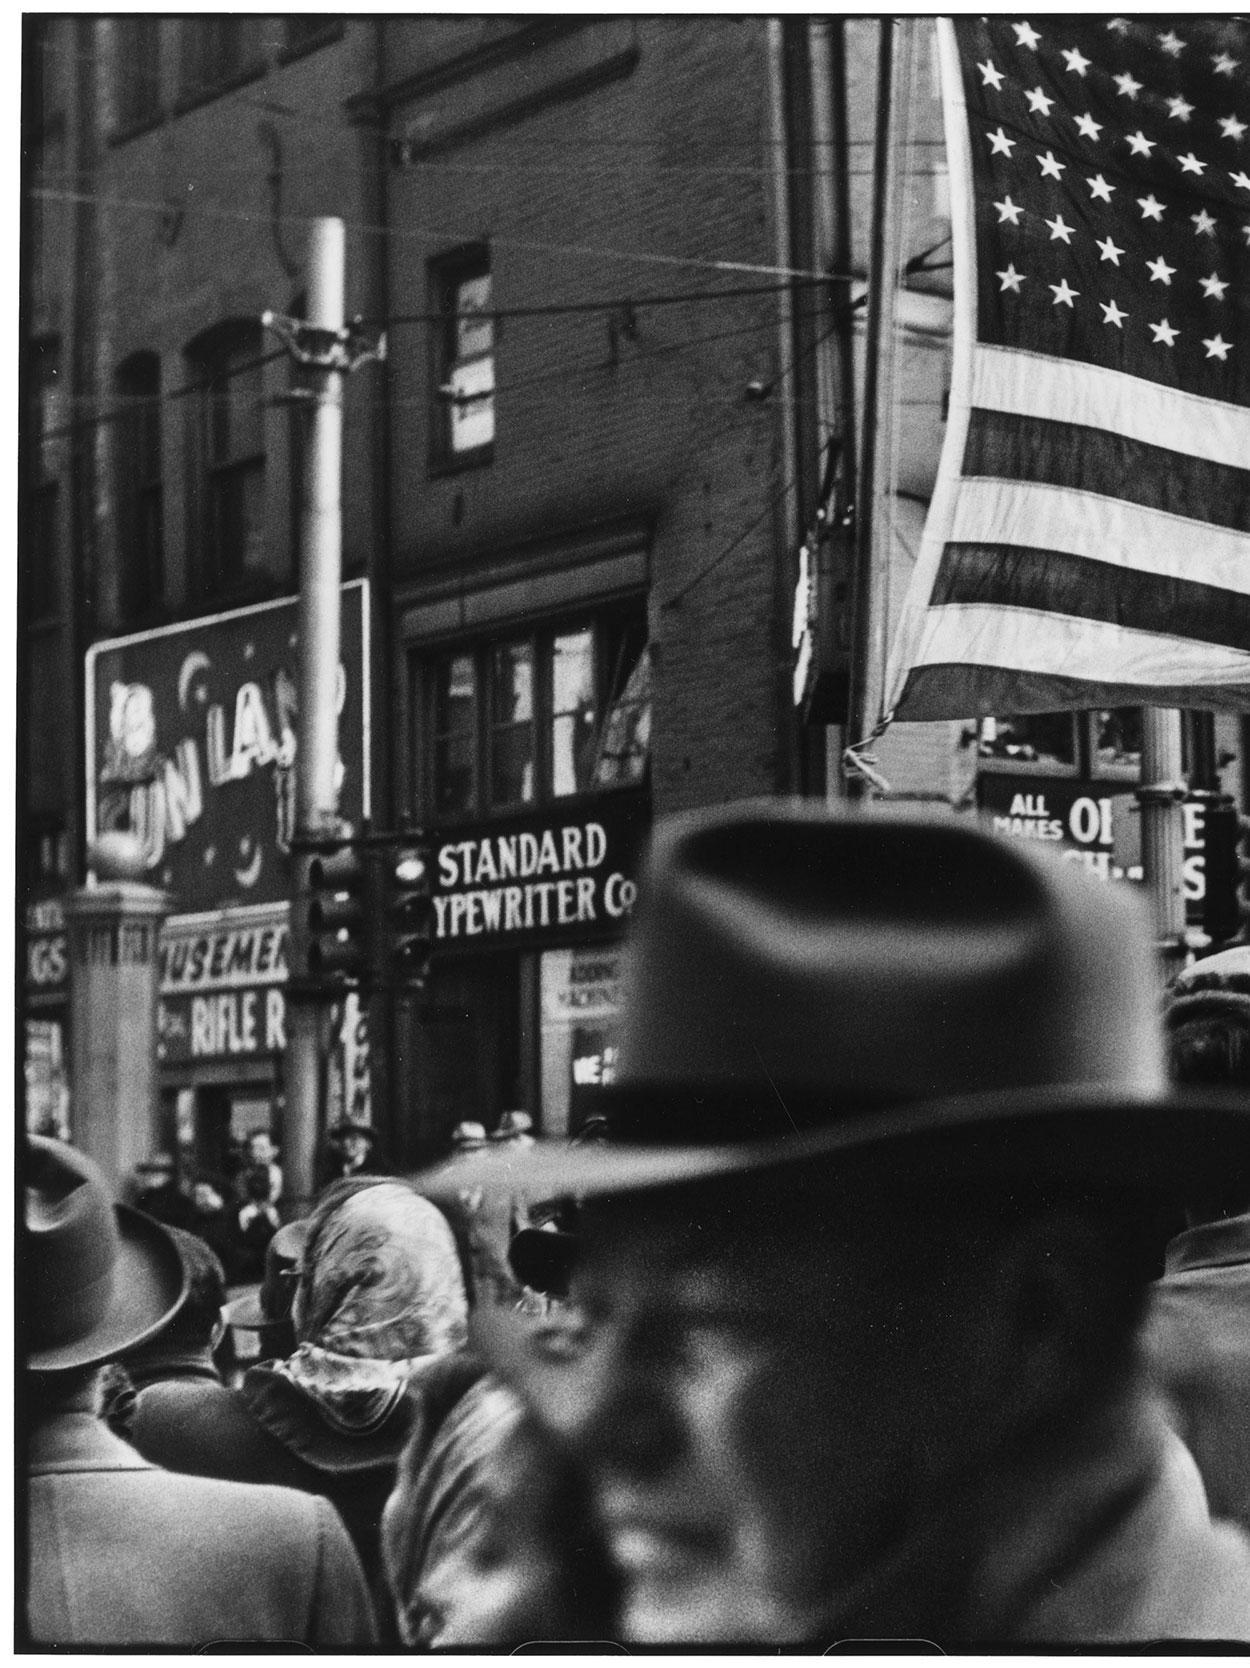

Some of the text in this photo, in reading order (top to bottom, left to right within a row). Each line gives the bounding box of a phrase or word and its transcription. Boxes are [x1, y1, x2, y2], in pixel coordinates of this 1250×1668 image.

[993, 816, 1064, 841] MAKES
[1010, 793, 1050, 816] ALL
[438, 822, 607, 887] STANDARD
[433, 876, 596, 938] YPEWRITER
[191, 991, 257, 1055] RIFLE
